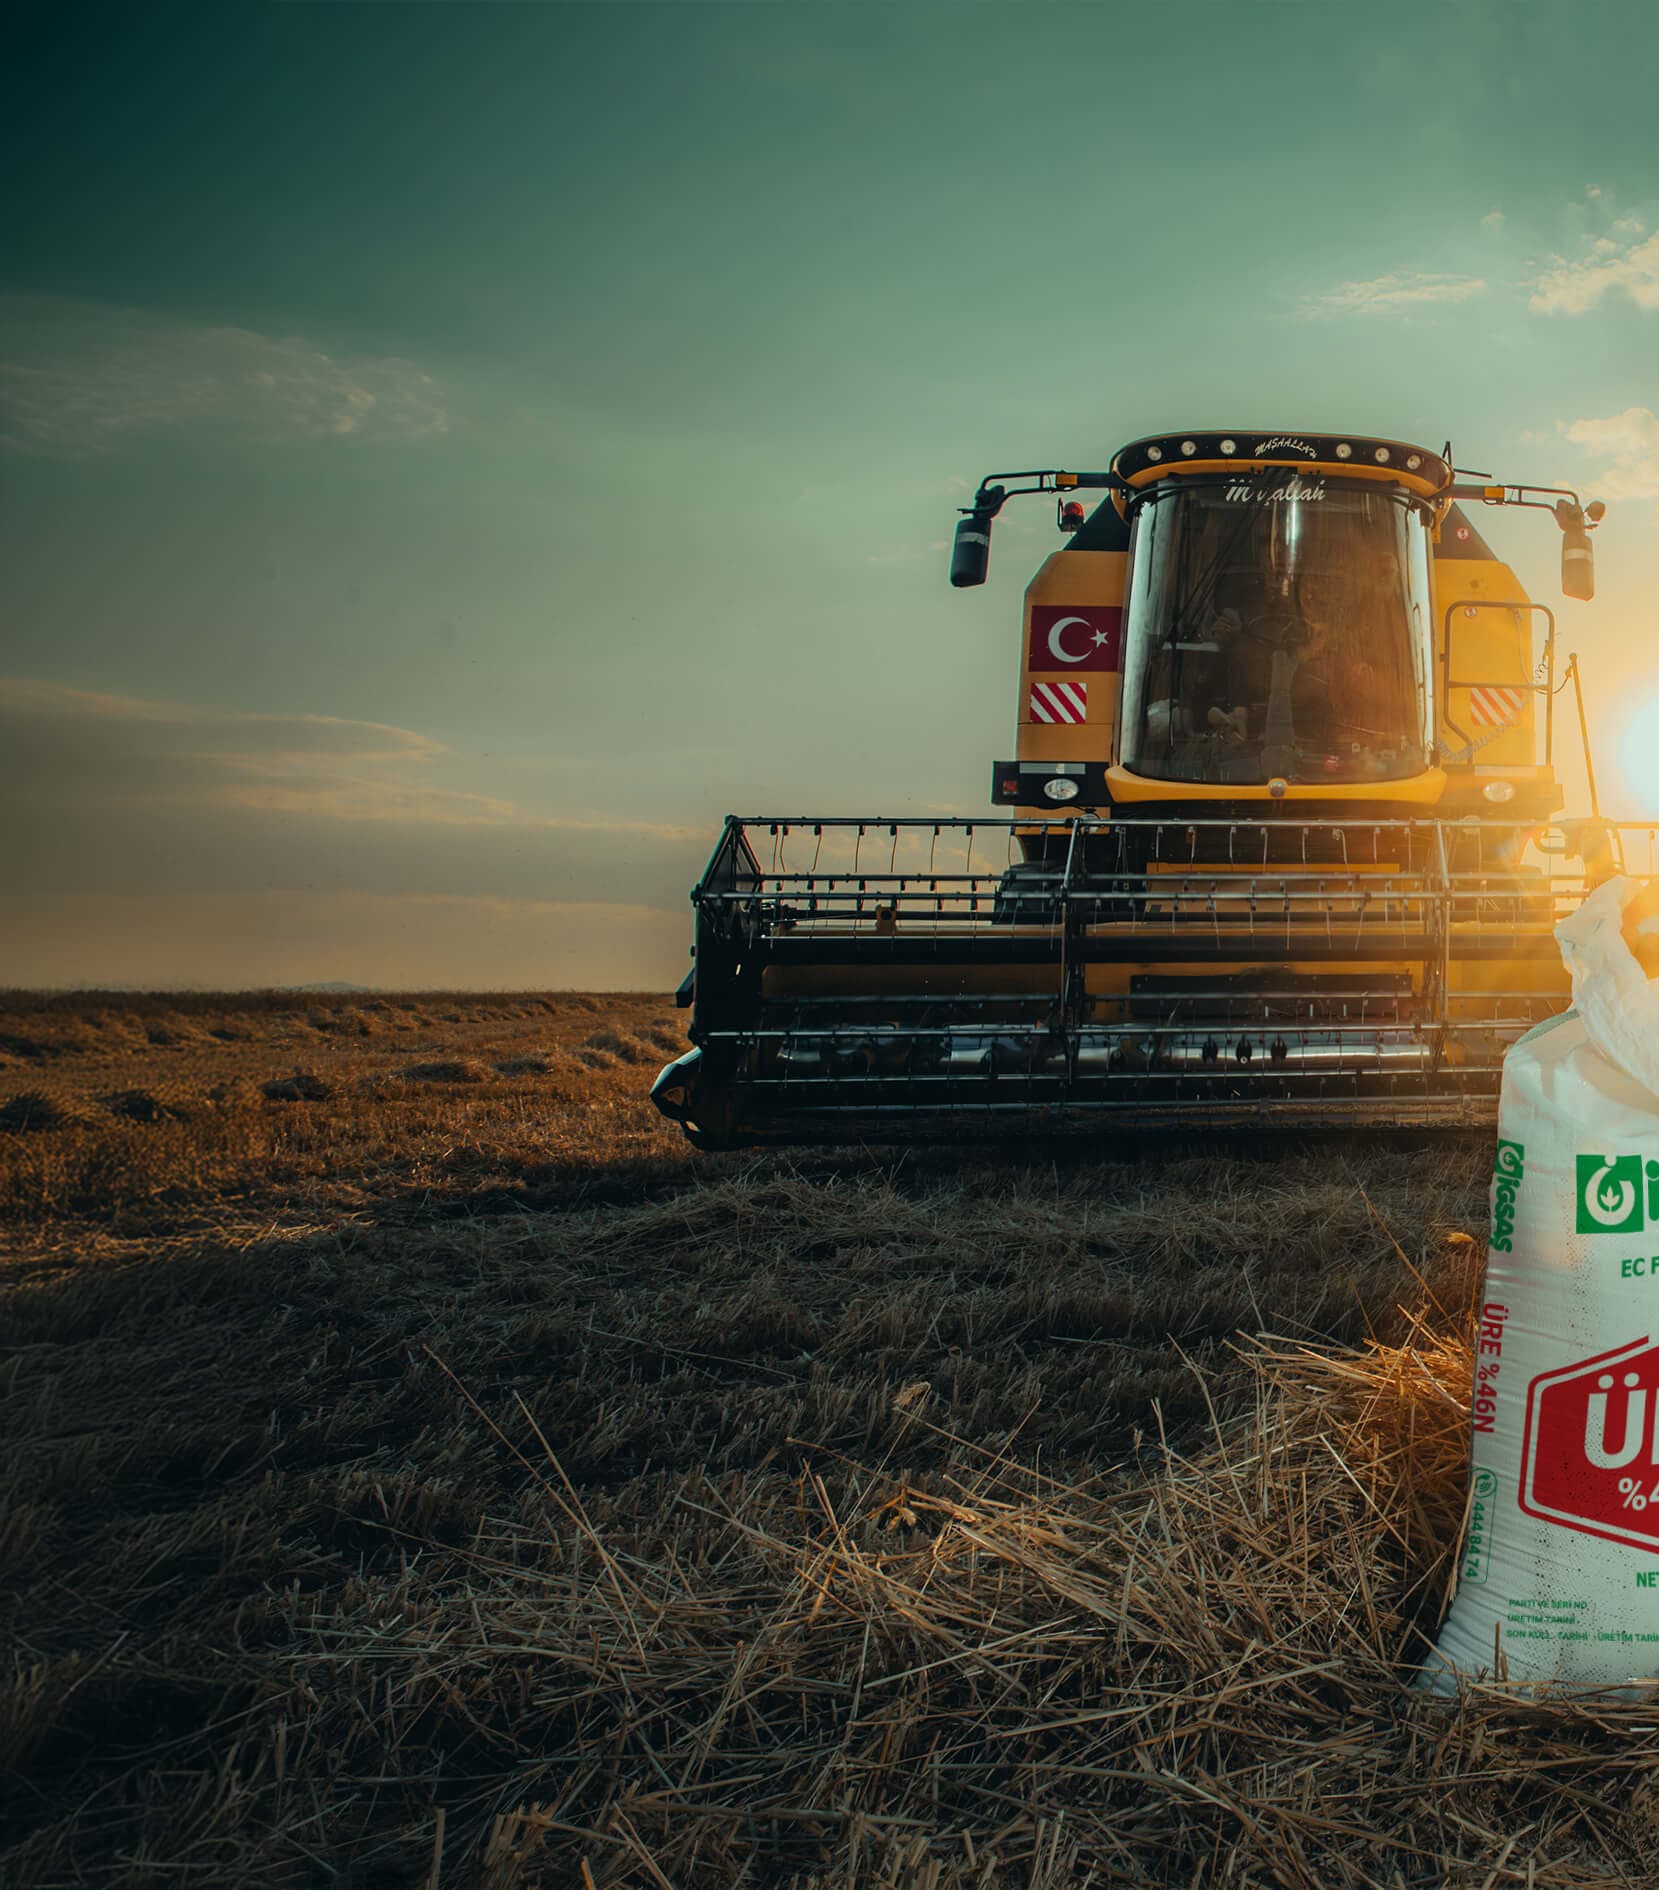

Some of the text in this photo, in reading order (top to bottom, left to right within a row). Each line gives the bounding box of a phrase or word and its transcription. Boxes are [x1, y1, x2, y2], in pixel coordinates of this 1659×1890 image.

[1621, 1258, 1646, 1278] EC
[1474, 1303, 1509, 1433] ÜRE %46N
[1465, 1501, 1485, 1578] 444 84 74
